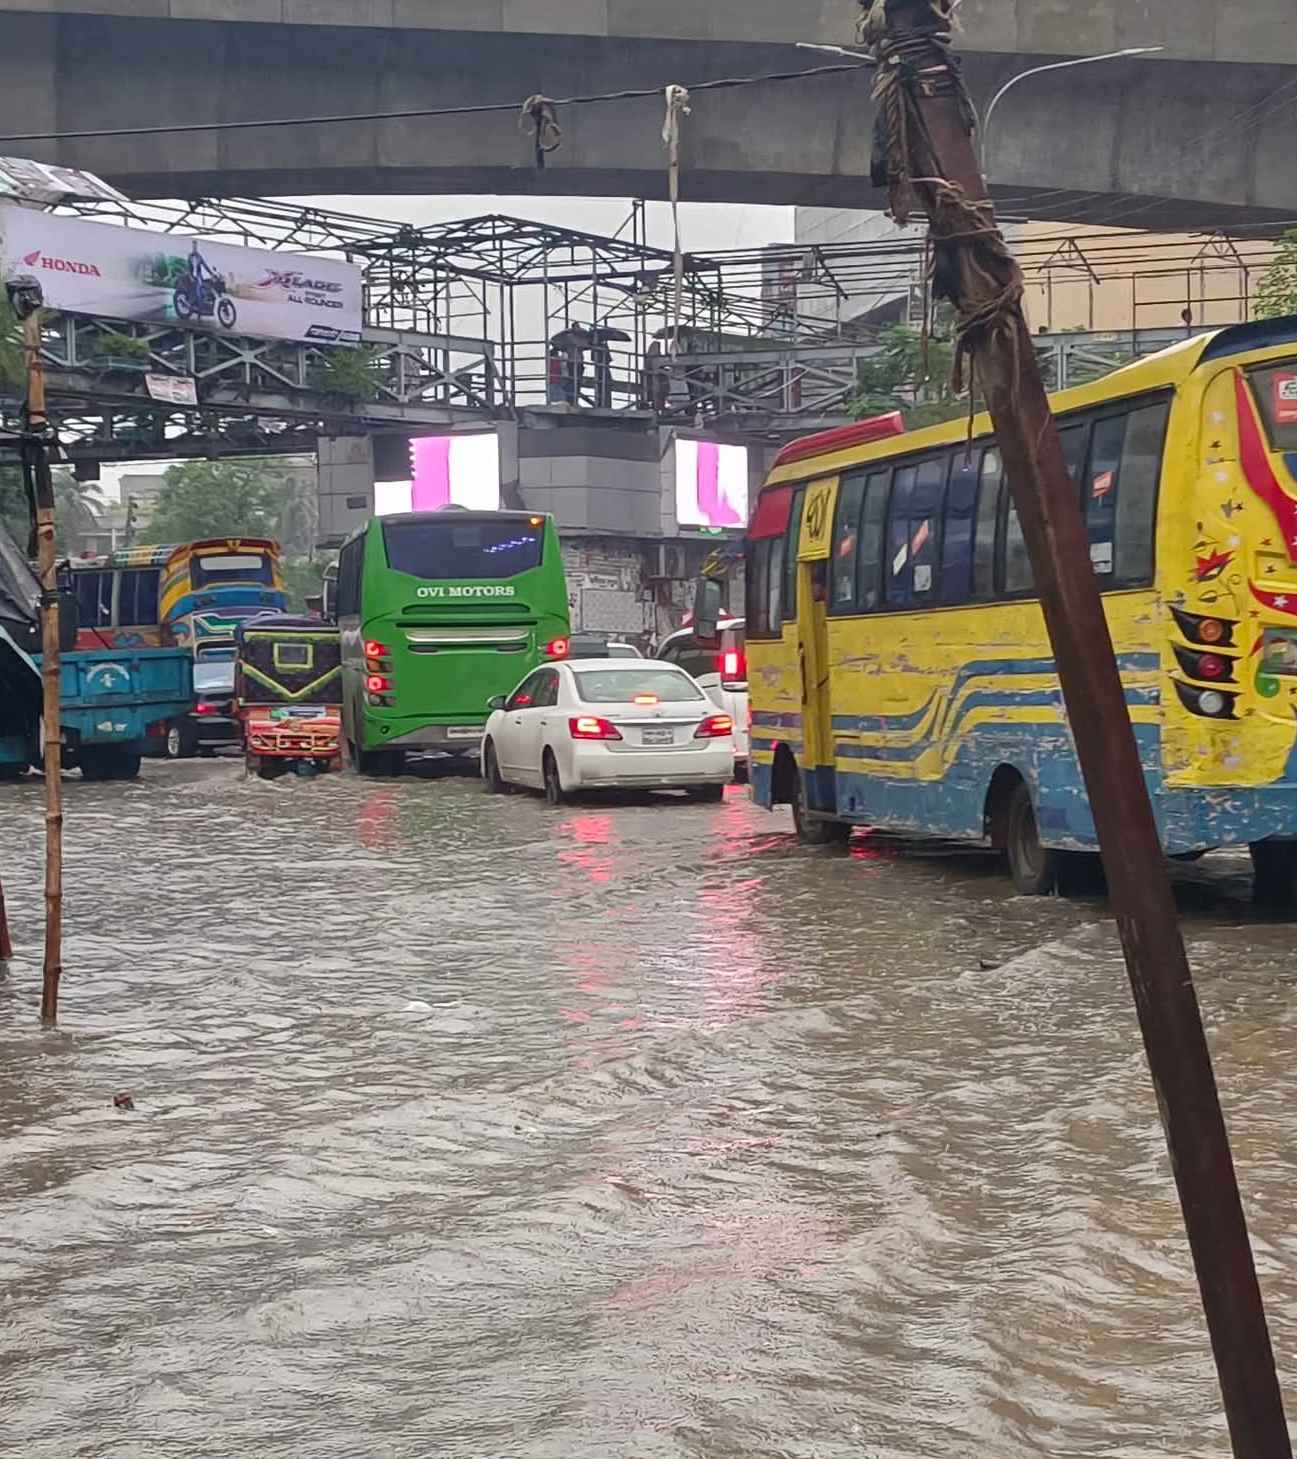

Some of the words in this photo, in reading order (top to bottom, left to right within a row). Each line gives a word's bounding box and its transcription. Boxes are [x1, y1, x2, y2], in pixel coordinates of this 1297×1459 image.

[41, 257, 101, 277] HONDA
[416, 586, 445, 598] OVI
[448, 586, 515, 597] MOTORS
